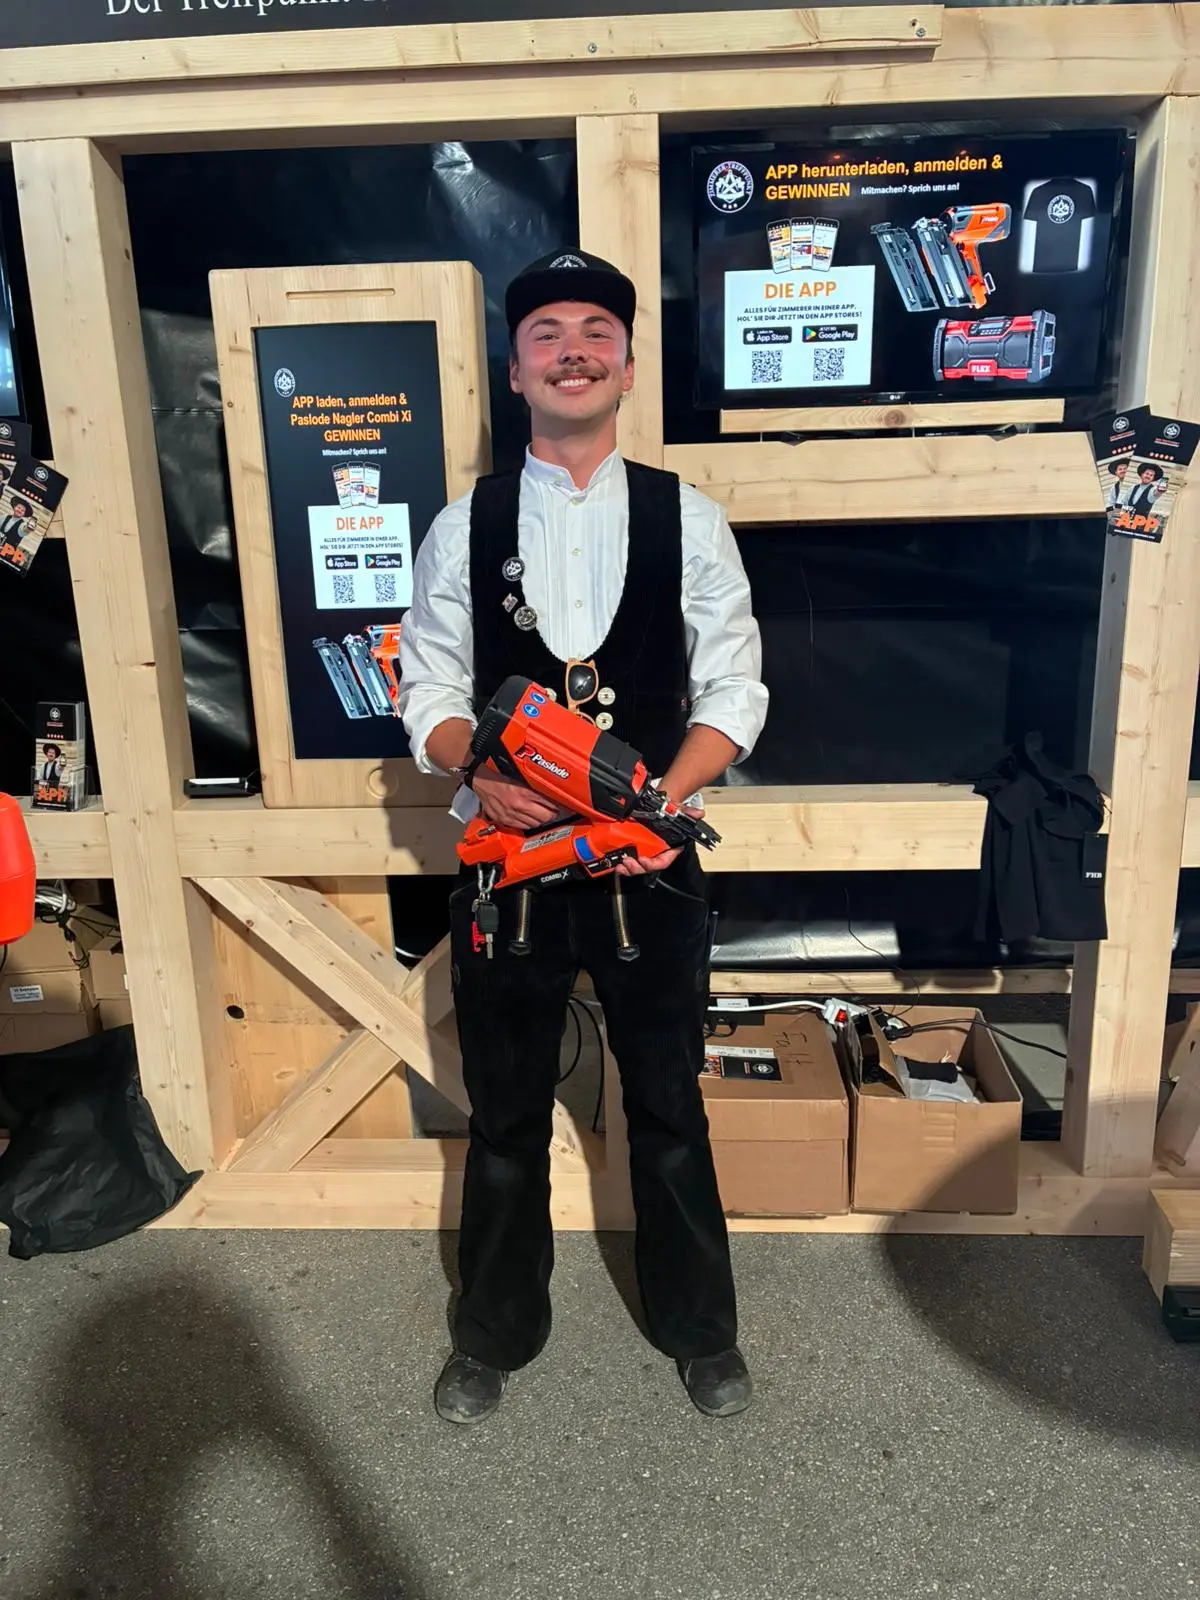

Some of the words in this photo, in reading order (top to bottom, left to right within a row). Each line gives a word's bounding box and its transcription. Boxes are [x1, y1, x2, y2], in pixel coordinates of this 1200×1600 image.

[765, 164, 798, 180] APP
[801, 160, 910, 178] herunterladen,
[914, 155, 987, 173] anmelden
[991, 154, 1003, 169] &
[765, 182, 851, 200] GEWINNEN
[861, 185, 907, 195] Mitmachen?
[908, 183, 931, 195] Sprich
[932, 184, 946, 192] uns
[947, 182, 960, 191] an!
[765, 283, 794, 299] DIE
[799, 281, 837, 298] APP
[764, 305, 777, 313] FÜR
[778, 305, 812, 313] ZIMMERER
[756, 334, 770, 342] App
[771, 333, 789, 341] Store
[818, 331, 840, 340] Google
[841, 330, 855, 339] Play
[971, 365, 991, 373] FLEX
[292, 395, 314, 409] APP
[316, 395, 347, 409] laden,
[348, 393, 397, 406] anmelden
[399, 392, 407, 405] &
[290, 412, 330, 426] Paslode
[332, 412, 365, 427] Nagler
[366, 410, 399, 423] Combi
[401, 410, 412, 422] Xi
[324, 428, 380, 442] GEWINNEN
[336, 517, 356, 530] DIE
[359, 516, 384, 530] APP
[1115, 512, 1159, 532] APP
[334, 560, 344, 568] App
[376, 559, 391, 568] Google
[531, 753, 570, 779] Paslode
[540, 872, 561, 883] COMBI
[562, 868, 569, 880] X
[1085, 871, 1103, 879] FHB
